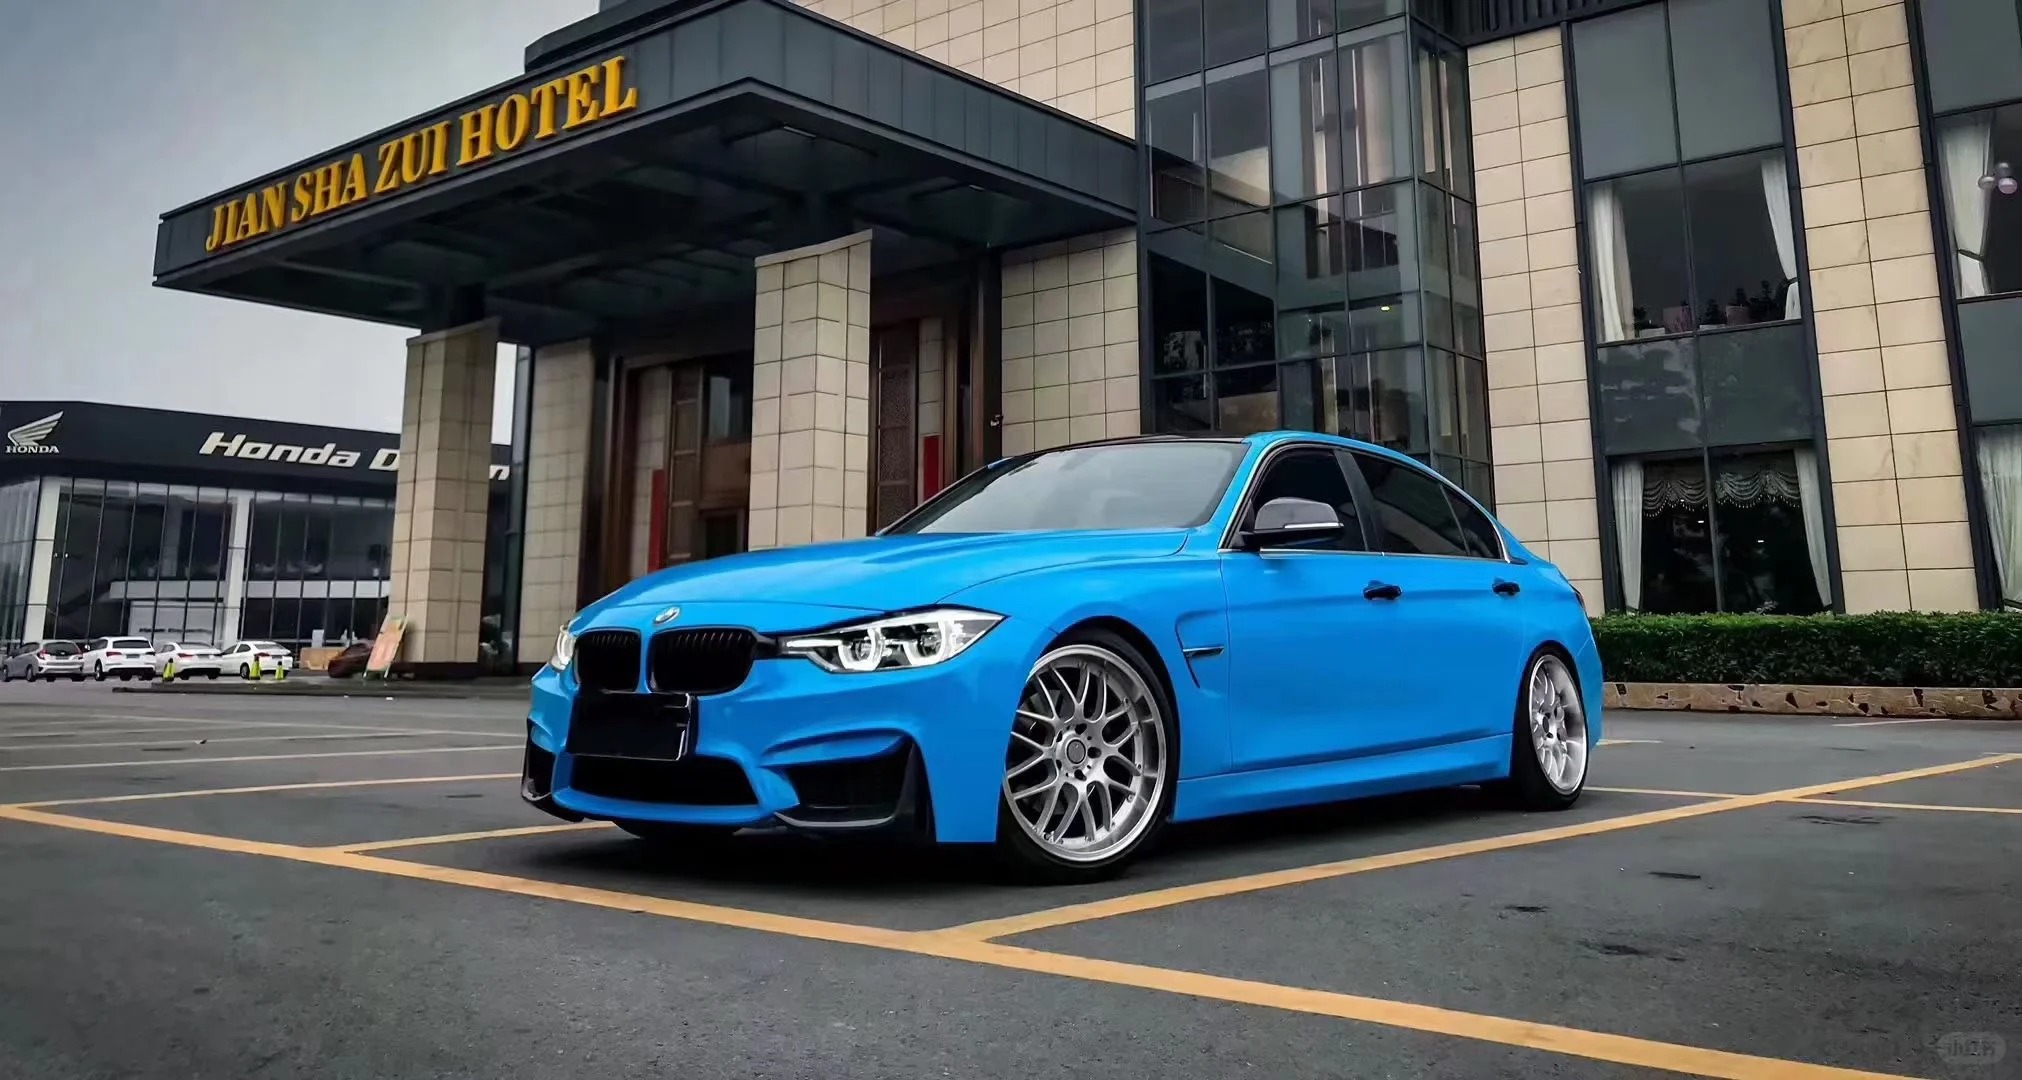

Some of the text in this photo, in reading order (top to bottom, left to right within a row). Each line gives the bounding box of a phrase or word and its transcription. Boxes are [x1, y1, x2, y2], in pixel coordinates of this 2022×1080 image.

[205, 56, 638, 251] JIAN SHA ZUI HOTEL
[5, 445, 60, 454] HONDA
[199, 431, 361, 468] Honda
